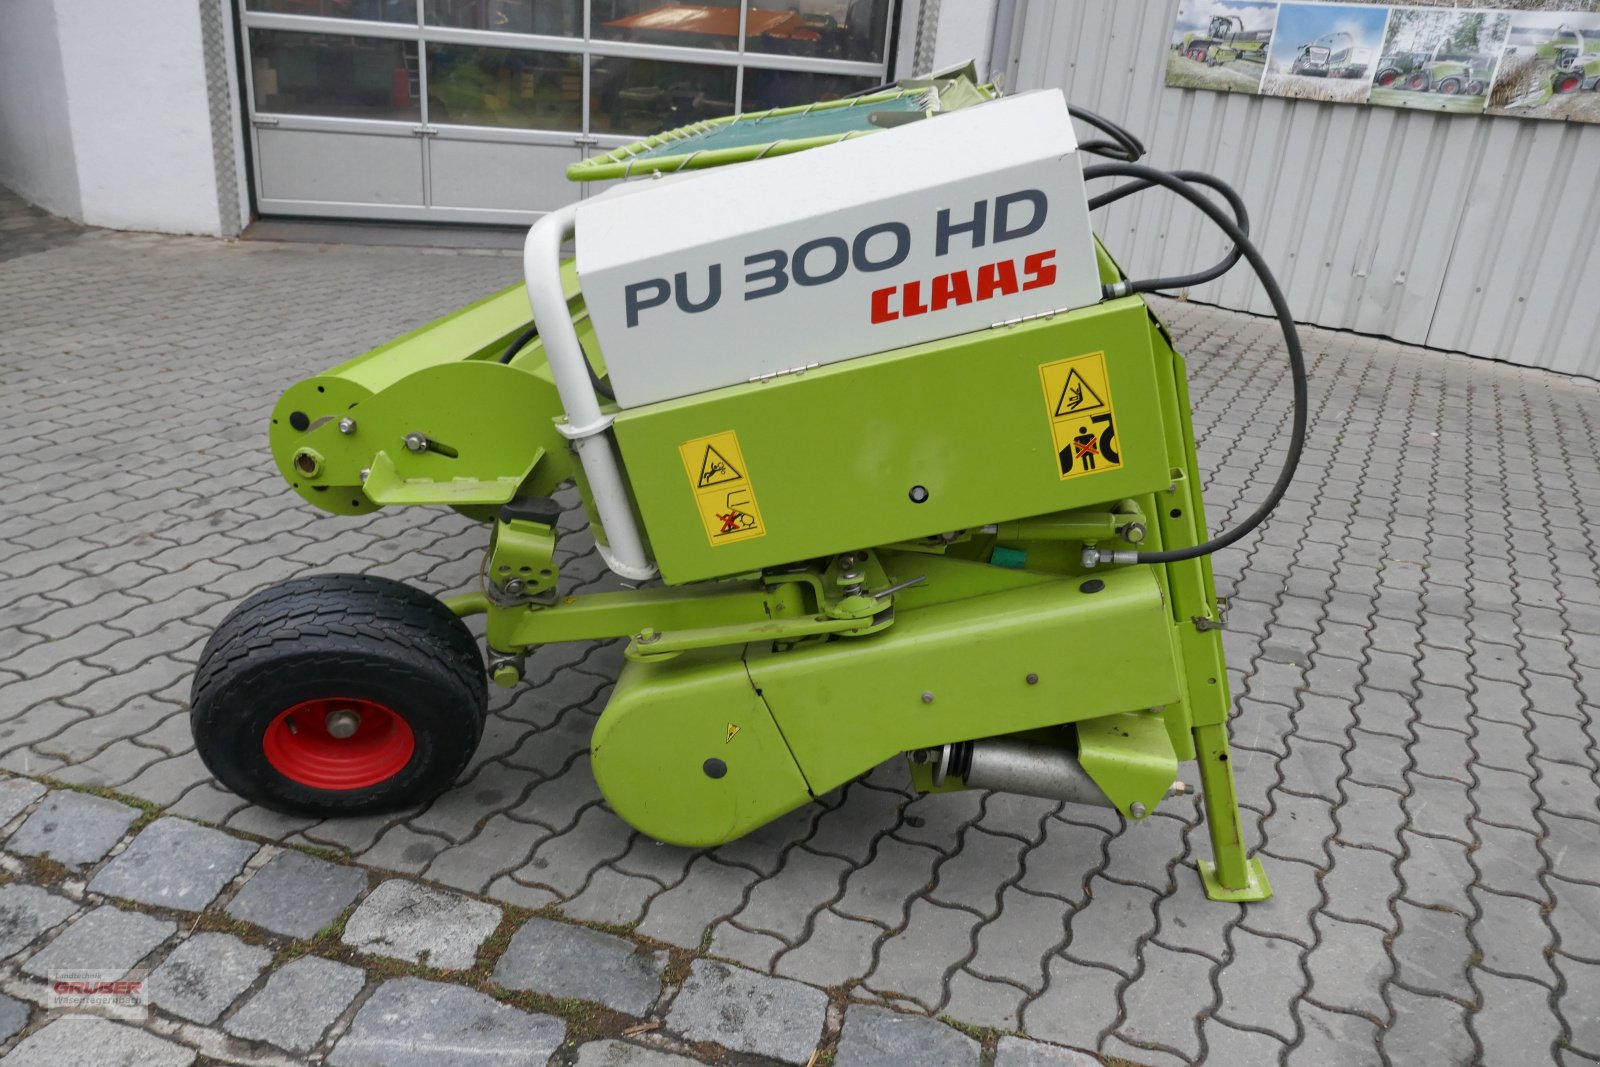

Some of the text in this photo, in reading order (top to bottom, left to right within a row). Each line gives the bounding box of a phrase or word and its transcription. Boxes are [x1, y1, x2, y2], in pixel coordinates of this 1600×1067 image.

[625, 189, 1048, 328] PU 300 HD
[870, 249, 1057, 325] CLAAS
